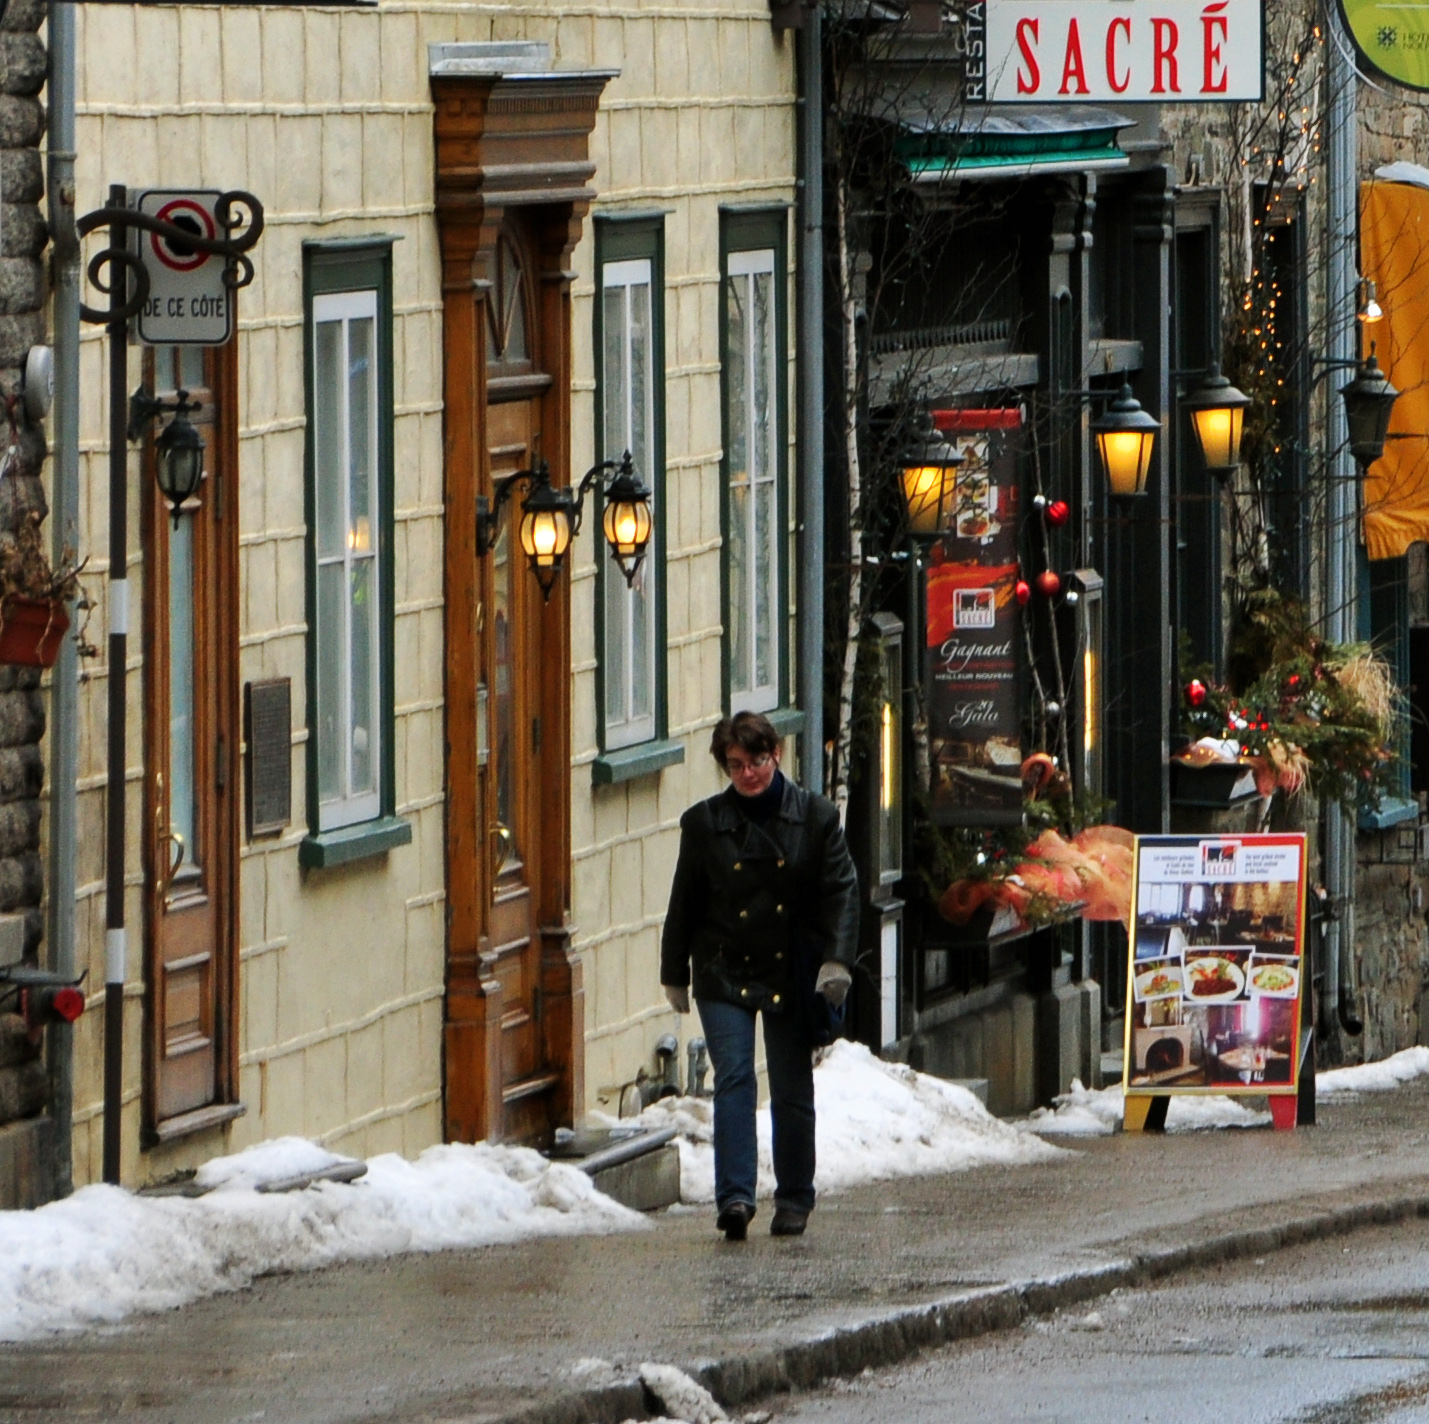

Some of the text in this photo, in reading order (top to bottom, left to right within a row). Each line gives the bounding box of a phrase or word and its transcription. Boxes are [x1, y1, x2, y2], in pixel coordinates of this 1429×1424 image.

[1016, 0, 1230, 94] SACRÉ
[144, 293, 224, 317] DE CE CÔTÉ
[940, 639, 1011, 673] Gagnant
